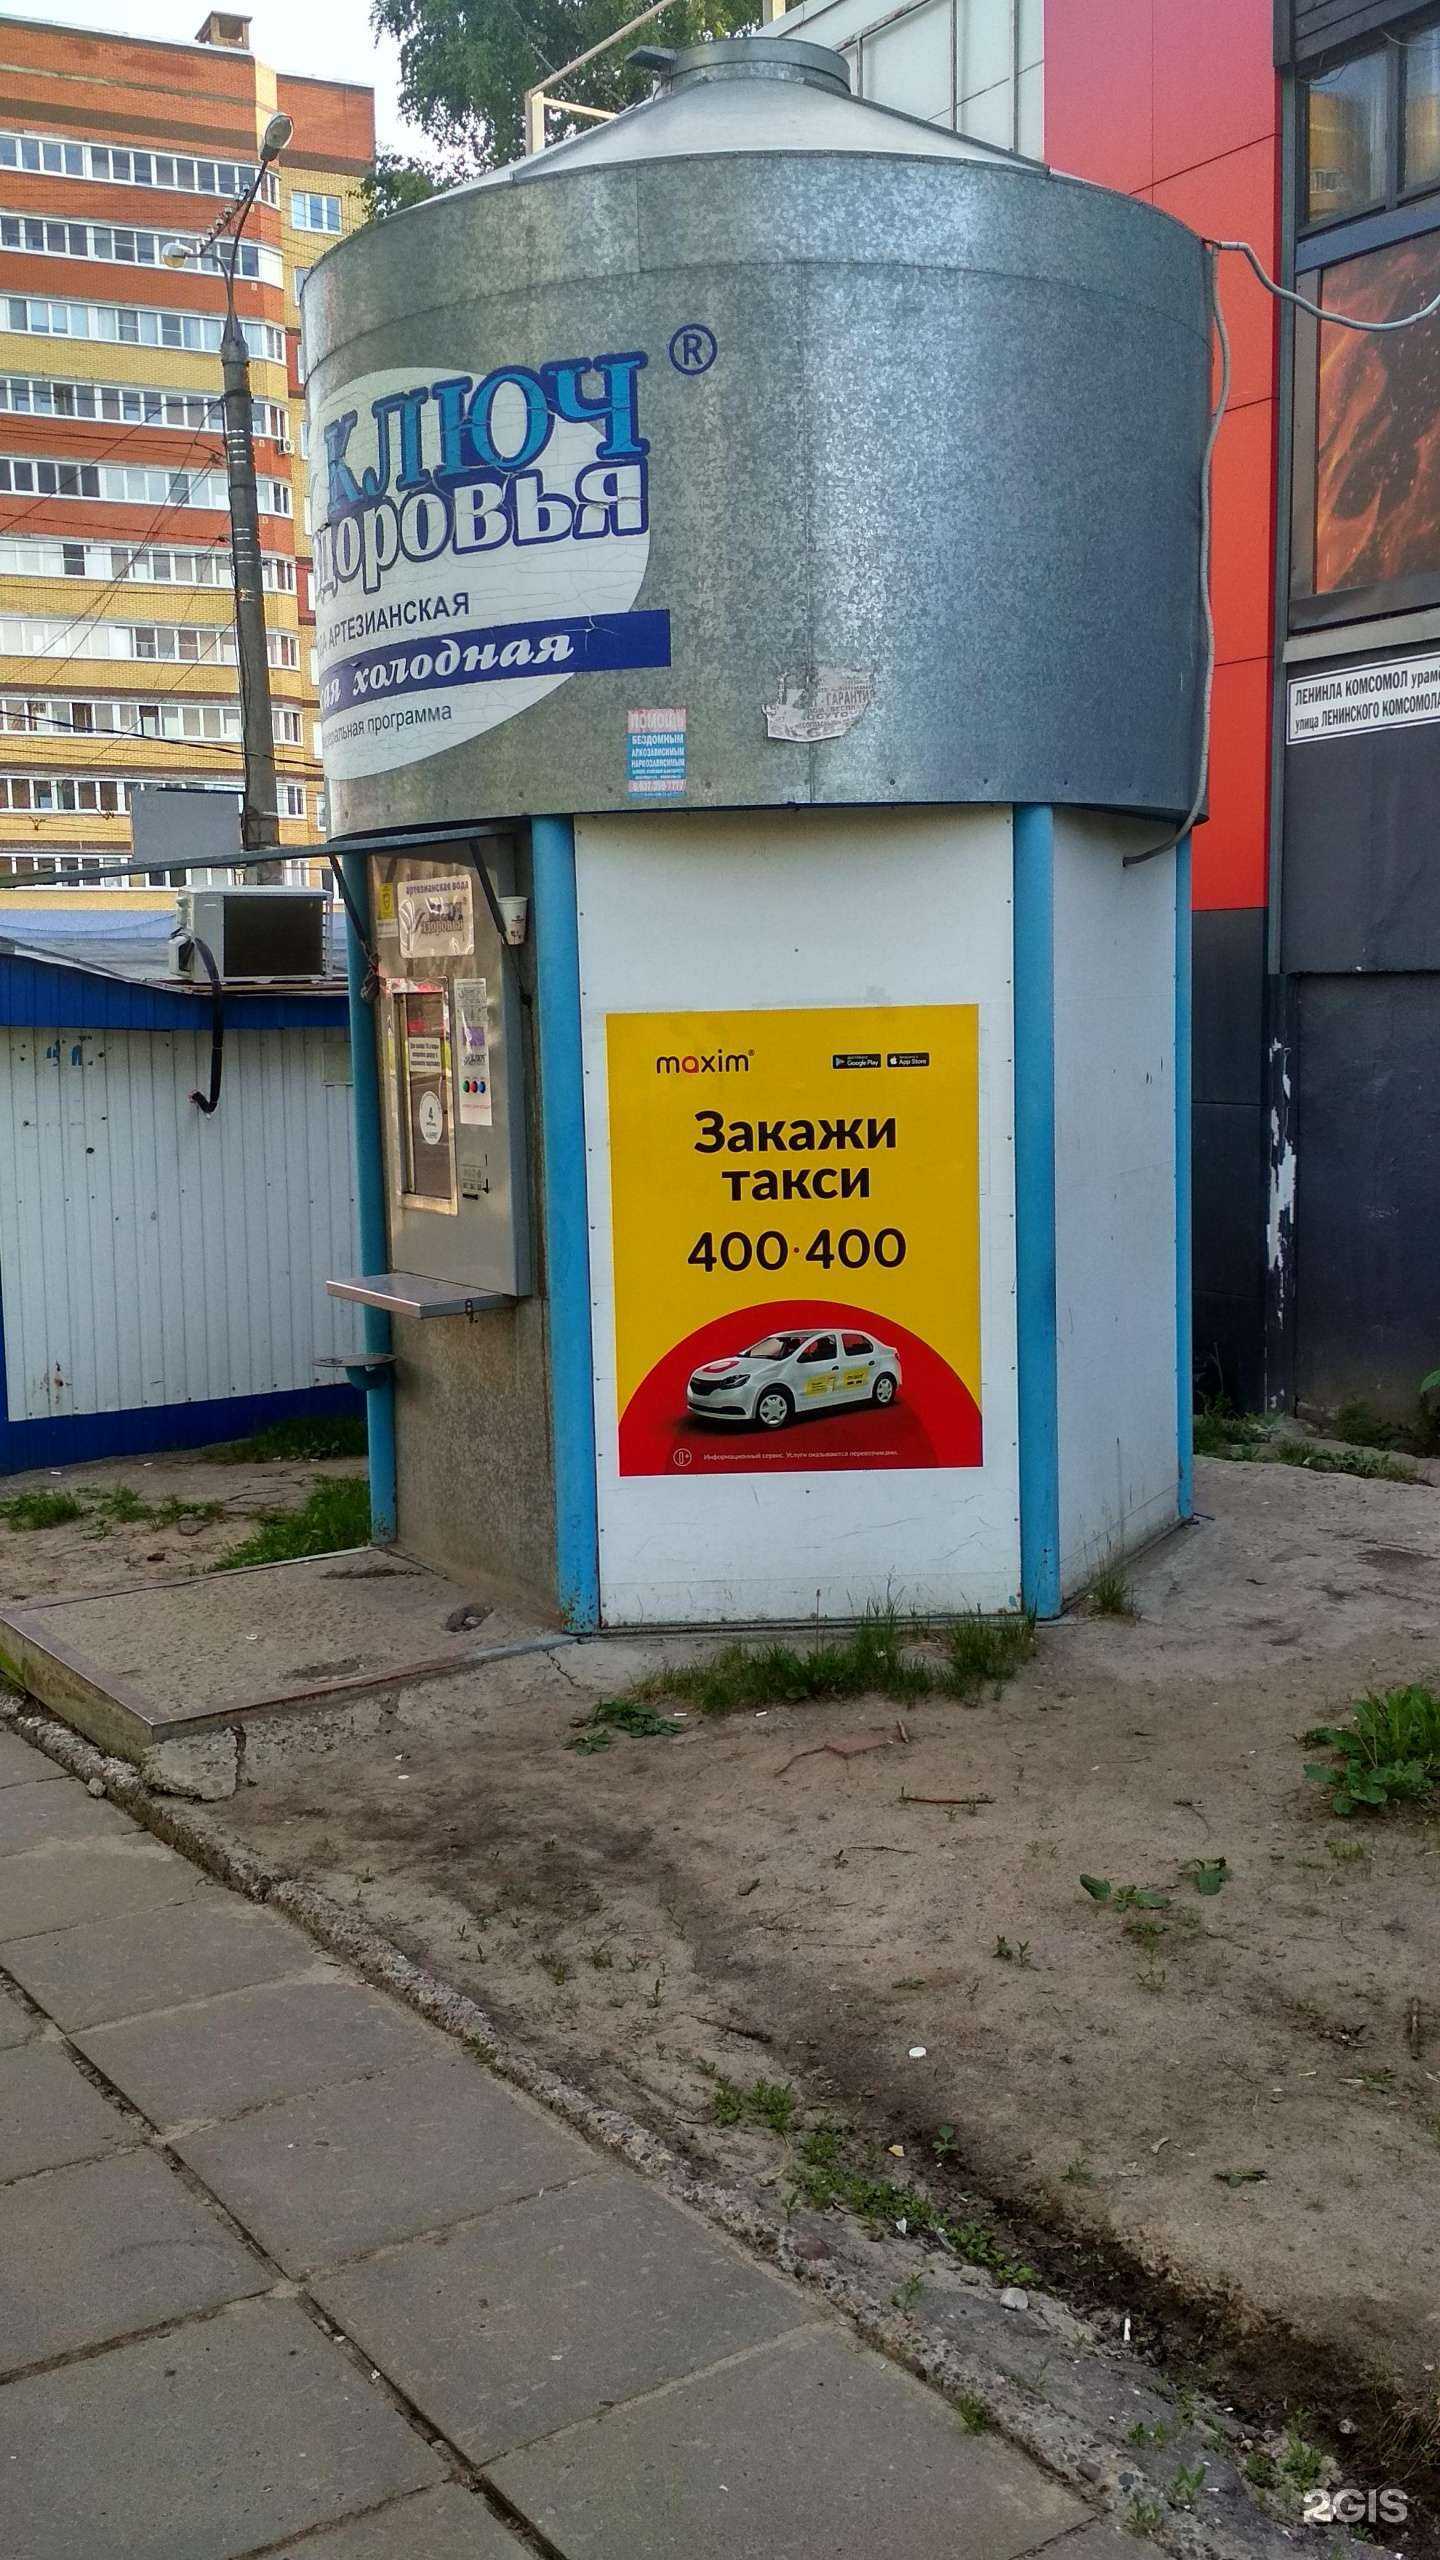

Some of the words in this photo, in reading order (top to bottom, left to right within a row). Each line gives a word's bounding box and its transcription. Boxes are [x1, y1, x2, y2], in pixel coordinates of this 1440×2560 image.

[323, 351, 650, 519] КЛЮЧ
[312, 456, 649, 604] доровья
[329, 592, 469, 648] АРТЕЗИАНСКАЯ
[352, 633, 574, 696] холодная
[1295, 681, 1342, 706] ЛЕНИНЛА
[1345, 670, 1408, 697] КОМСОМОЛ
[1411, 665, 1440, 689] урам
[367, 705, 452, 736] программа
[1295, 715, 1319, 734] улица
[1321, 701, 1380, 727] ЛЕНИНСКОГО
[632, 733, 684, 746] БЕЗДОМНЫМ
[693, 1110, 897, 1154] Закажи
[722, 1166, 871, 1201] такси
